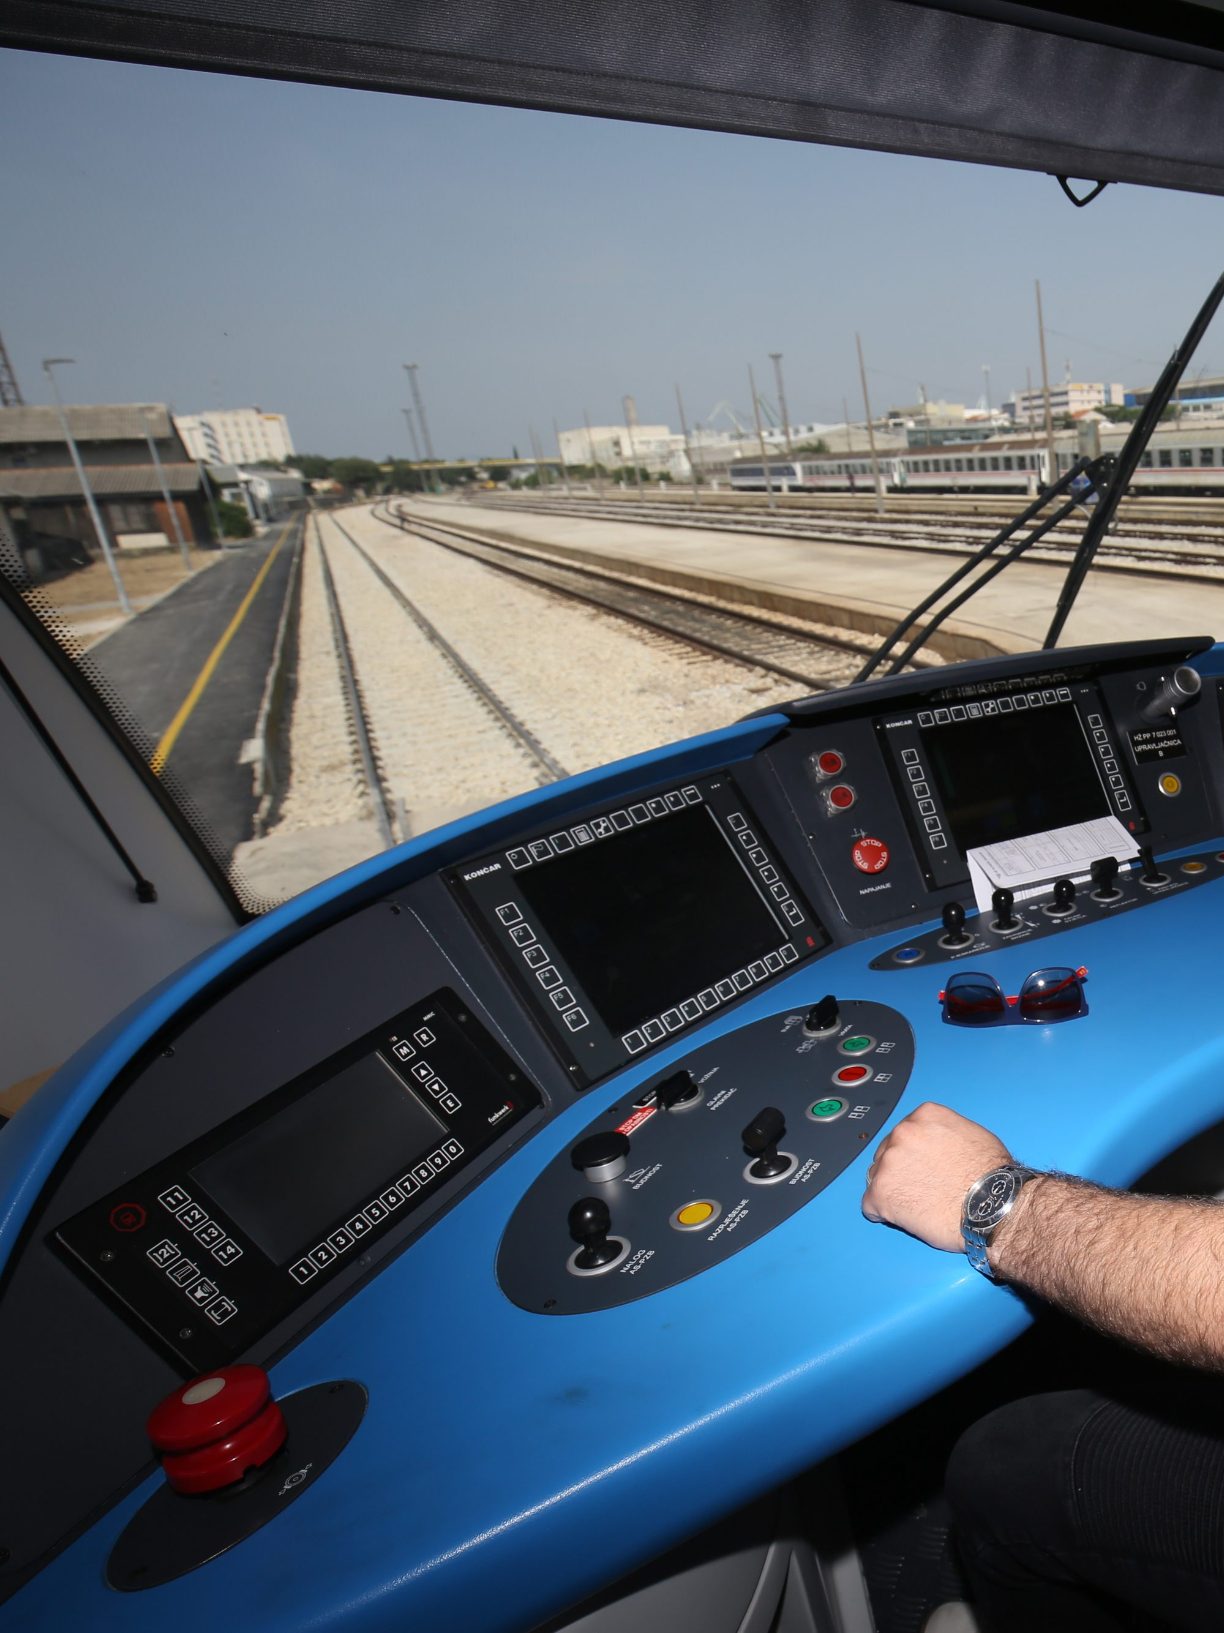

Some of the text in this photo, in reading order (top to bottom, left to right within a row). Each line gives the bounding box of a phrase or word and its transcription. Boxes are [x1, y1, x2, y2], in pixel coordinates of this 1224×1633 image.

[861, 839, 882, 848] STOP
[855, 849, 869, 870] STOP
[874, 851, 888, 870] STOP
[859, 883, 892, 895] NAPAJANJE
[500, 907, 510, 916] F1
[513, 929, 524, 937] F2
[527, 950, 537, 958] F3
[554, 993, 564, 1001] F5
[420, 1033, 430, 1042] R
[399, 1045, 410, 1056] M
[446, 1099, 455, 1108] E
[488, 1104, 509, 1123] funkwerk
[632, 1163, 663, 1190] BUDNOST
[789, 1158, 815, 1185] BUDNOST
[166, 1191, 184, 1205] 11
[183, 1209, 202, 1224] 12
[298, 1145, 457, 1275] 1 2 3 4 5 6 7 8 9 0
[726, 1209, 749, 1232] AS-PZB
[200, 1227, 219, 1241] 13
[218, 1244, 236, 1259] 14
[620, 1249, 646, 1273] NALOG
[629, 1250, 655, 1275] AS-PZB
